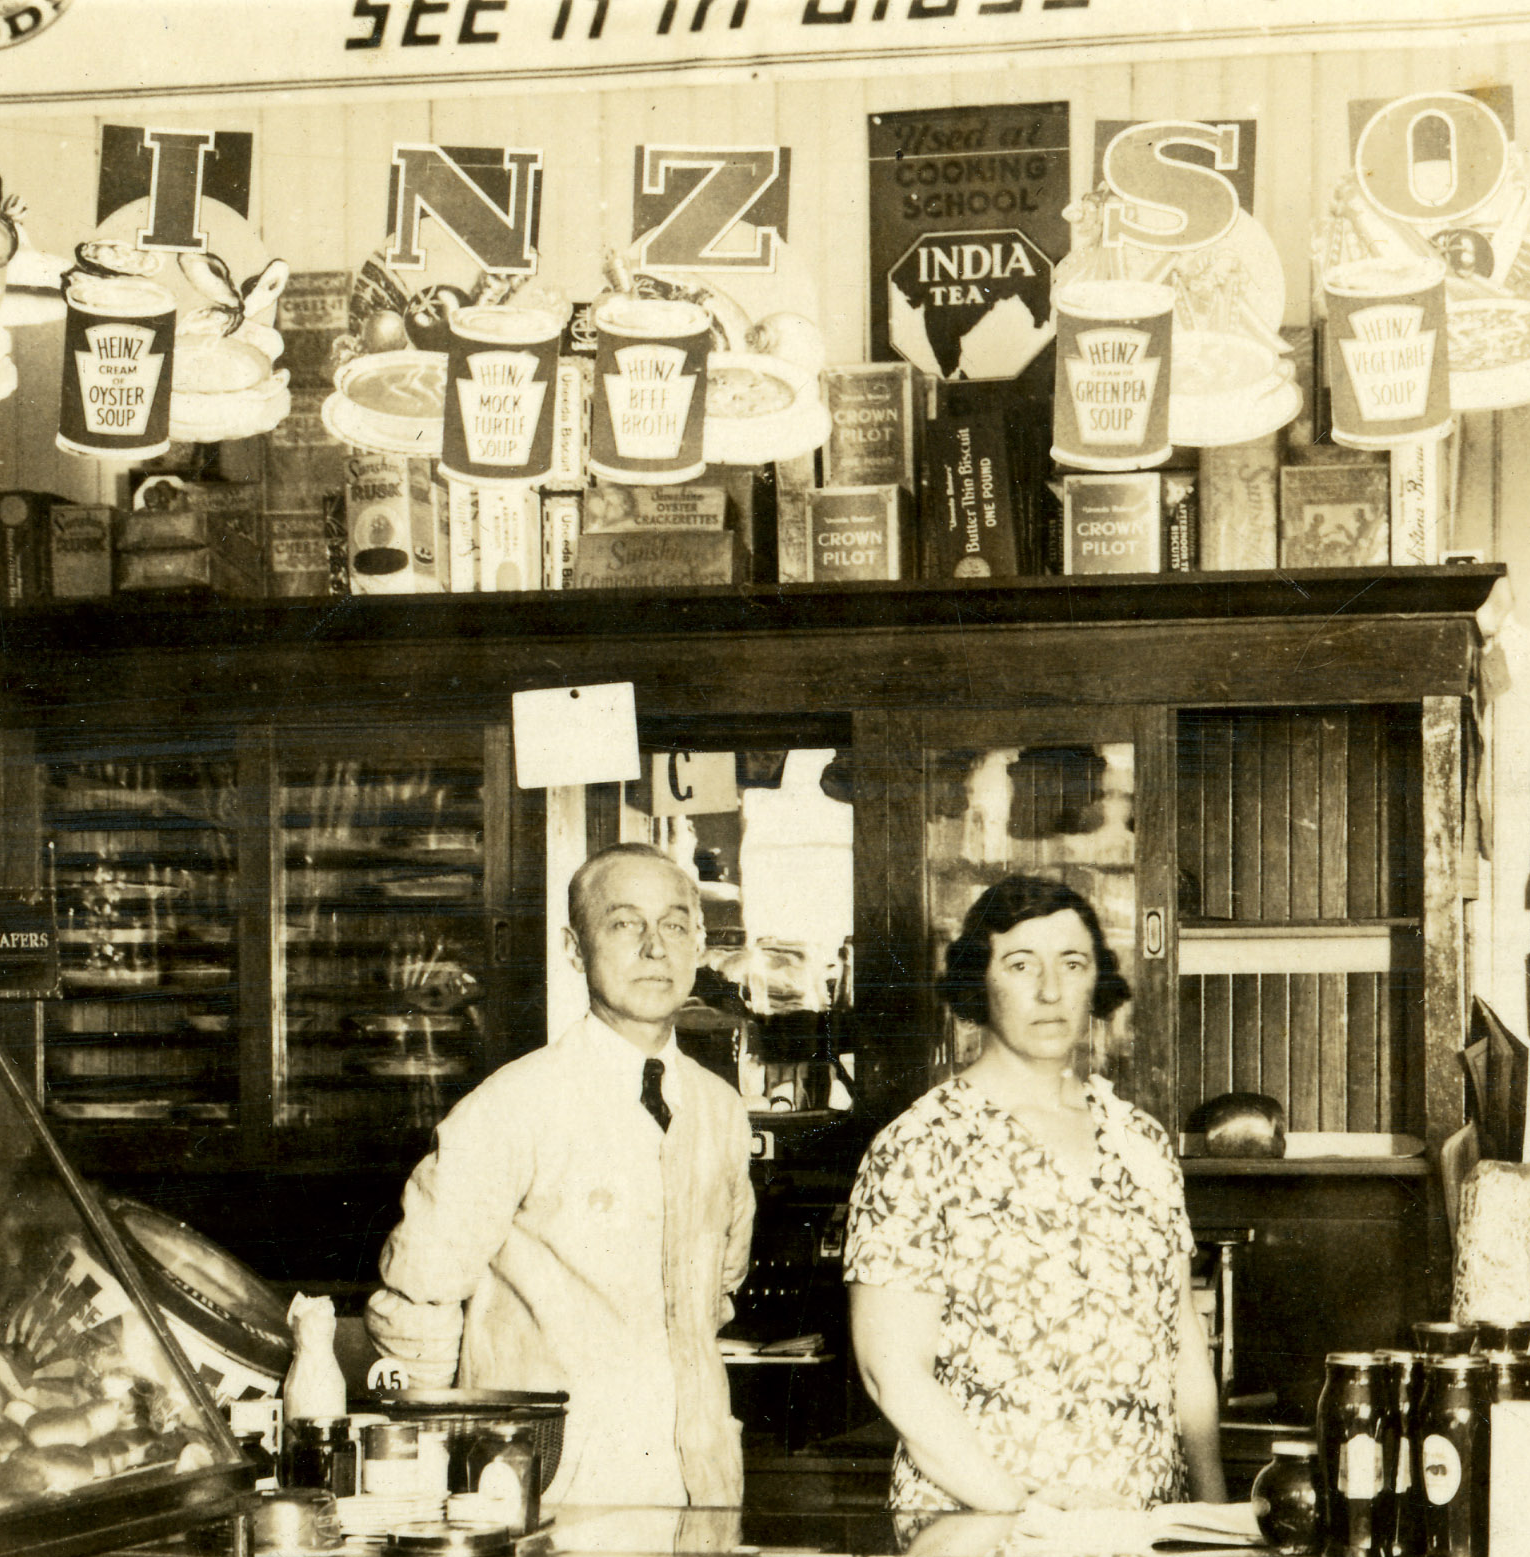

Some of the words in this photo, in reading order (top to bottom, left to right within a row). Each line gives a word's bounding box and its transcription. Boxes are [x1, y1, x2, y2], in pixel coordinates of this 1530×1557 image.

[894, 118, 989, 155] Used
[894, 155, 1048, 189] COOKING
[901, 187, 1040, 220] SCHOOL
[917, 241, 1037, 283] INDIA
[929, 284, 986, 307] TEA
[1360, 317, 1416, 343] HEINZ
[96, 335, 144, 362] HEINZ
[1087, 341, 1140, 366] HEINZ
[1351, 344, 1428, 376] VEGETABLE
[98, 365, 139, 375] CREAM
[478, 363, 524, 387] HEINZ
[627, 359, 675, 383] HEINZ
[88, 385, 144, 408] OYSTER
[629, 388, 670, 411] BEEF
[1076, 379, 1120, 403] GREEN
[1121, 379, 1148, 403] PEA
[1370, 381, 1417, 407] SOUP
[478, 394, 522, 414] MOCK
[832, 406, 899, 425] CROWN
[95, 408, 136, 428] SOUP
[473, 416, 528, 437] TURTLE
[621, 414, 679, 437] BROTH
[1088, 407, 1135, 432] SOUP
[838, 427, 895, 444] PILOT
[477, 438, 519, 458] SOUP
[955, 426, 974, 475] Biscuit
[978, 457, 994, 499] POUND
[958, 477, 976, 509] Thin
[656, 503, 698, 513] OYSTER
[982, 502, 997, 527] ONE
[817, 530, 883, 548] CROWN
[960, 508, 980, 553] Butter
[1076, 521, 1145, 537] CROWN
[822, 550, 878, 567] PILOT
[1080, 540, 1139, 557] PILOT
[1171, 525, 1181, 570] BISCUITS
